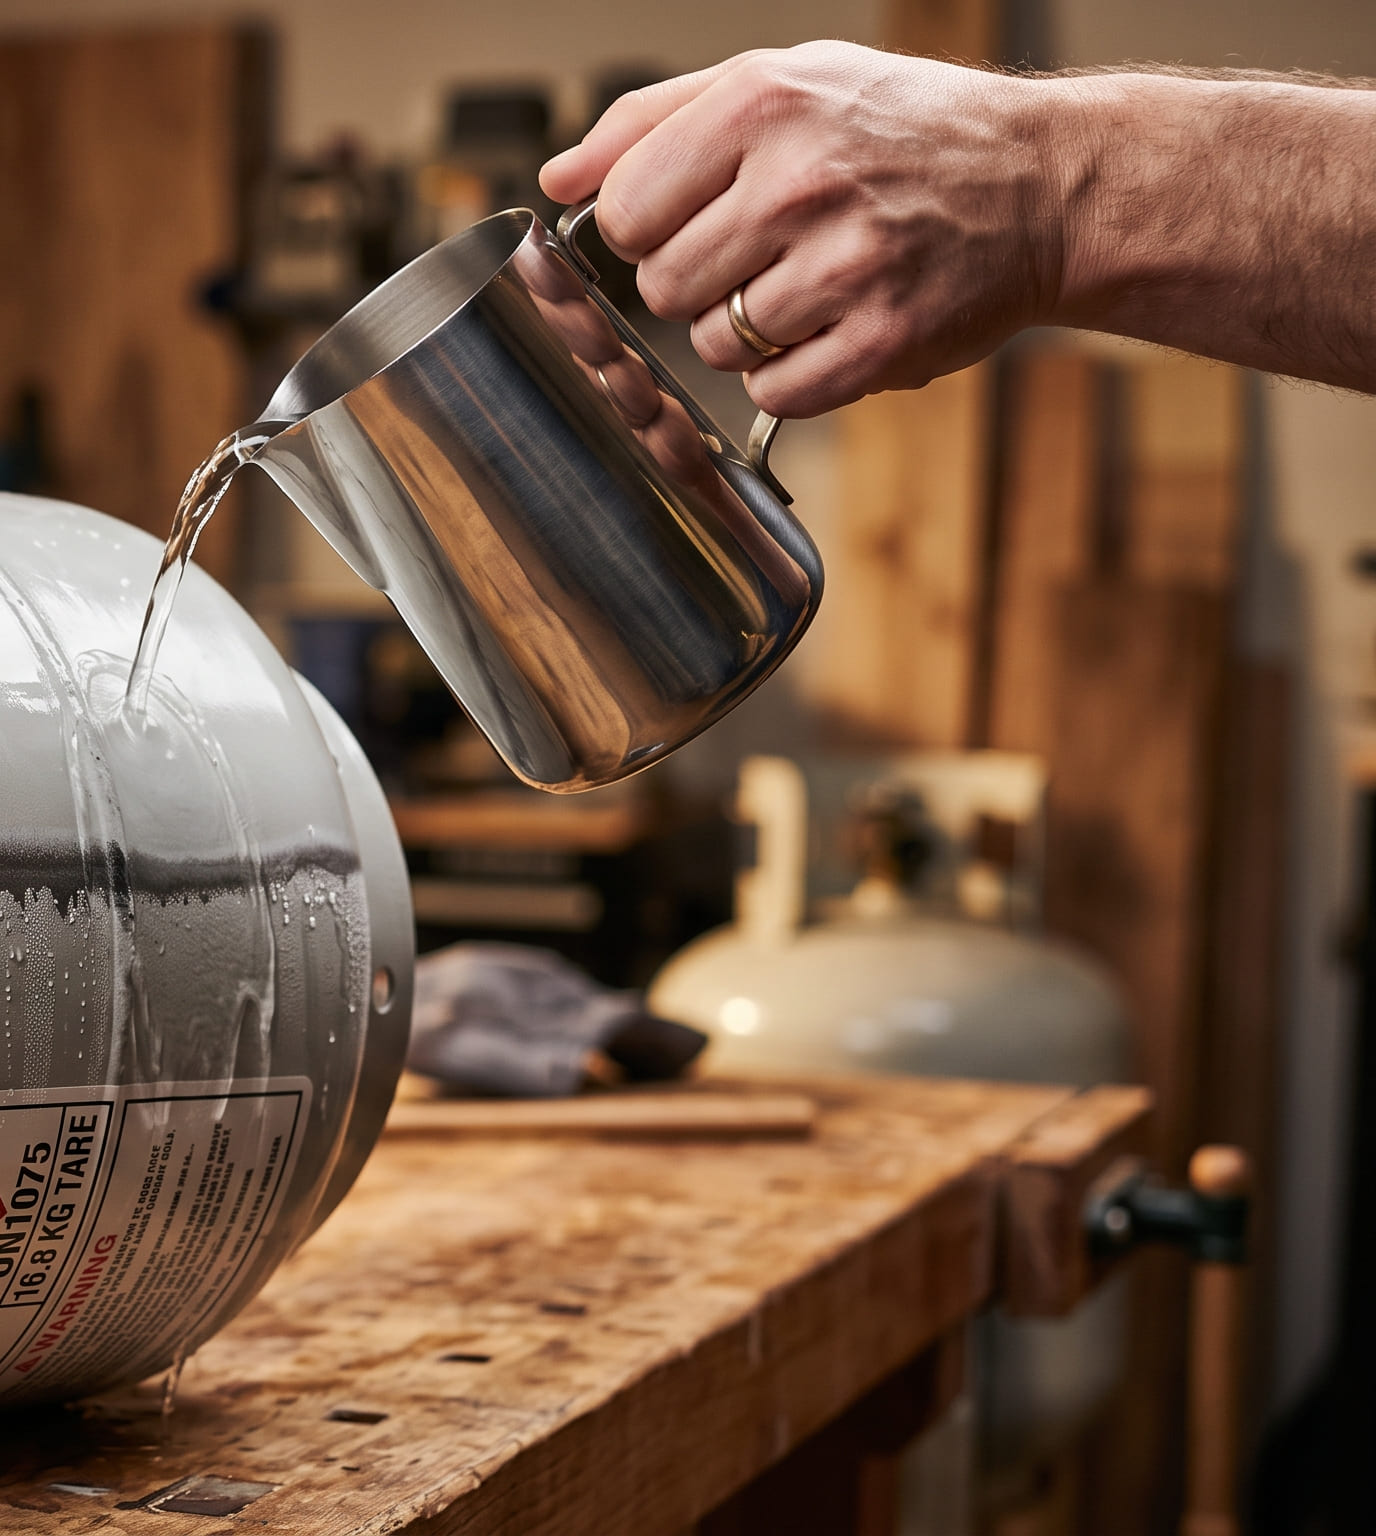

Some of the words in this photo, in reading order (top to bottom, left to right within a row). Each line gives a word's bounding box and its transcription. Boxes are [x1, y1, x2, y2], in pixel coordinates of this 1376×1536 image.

[55, 1114, 98, 1197] TARE
[38, 1203, 75, 1242] KG
[14, 1249, 57, 1301] 16.8
[33, 1234, 118, 1354] WARNING
